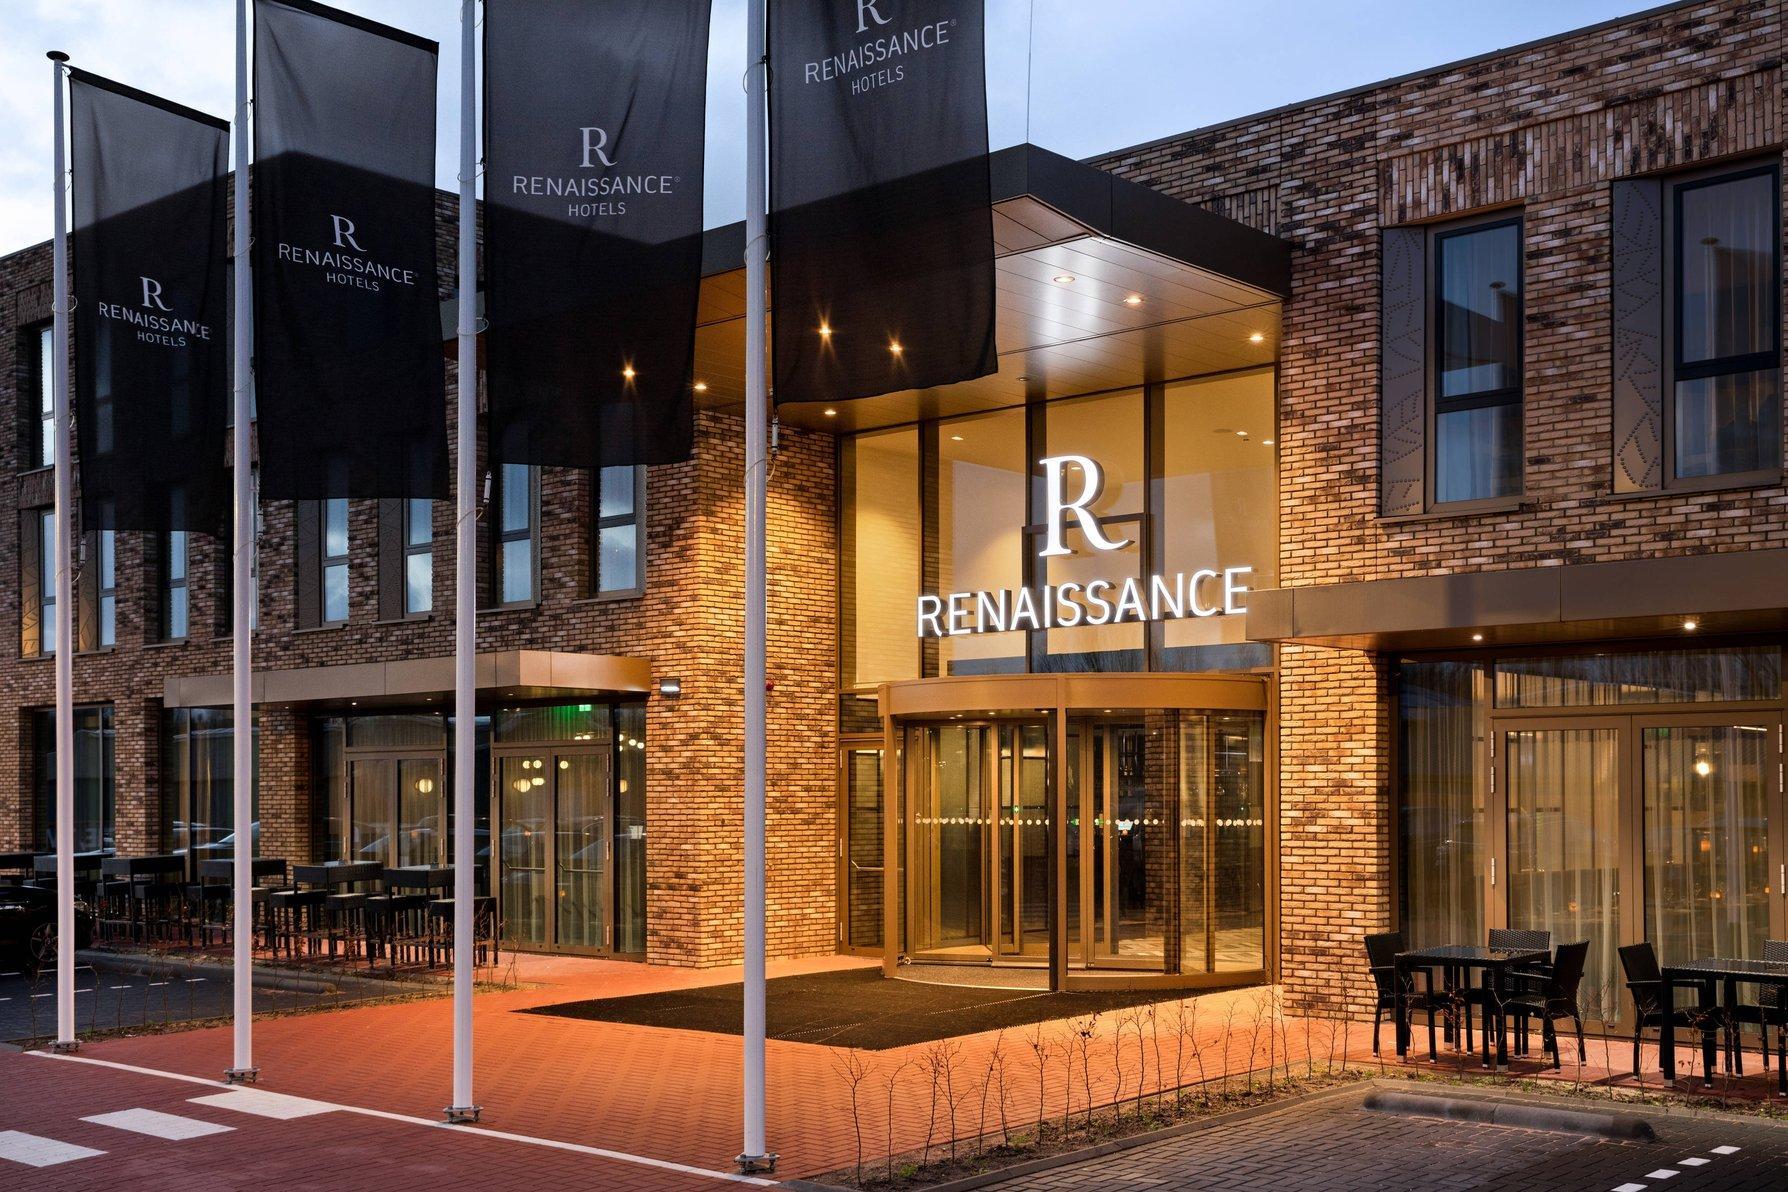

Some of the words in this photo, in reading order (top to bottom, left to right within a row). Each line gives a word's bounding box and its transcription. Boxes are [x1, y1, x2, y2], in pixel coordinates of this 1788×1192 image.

[851, 65, 904, 96] HOTELS
[579, 127, 618, 168] R
[568, 202, 626, 217] HOTELS
[330, 214, 368, 252] R
[140, 276, 174, 312] R
[326, 272, 380, 292] HOTELS
[137, 331, 187, 347] HOTELS
[1038, 455, 1130, 557] R
[917, 566, 1252, 638] RENAISSANCE
